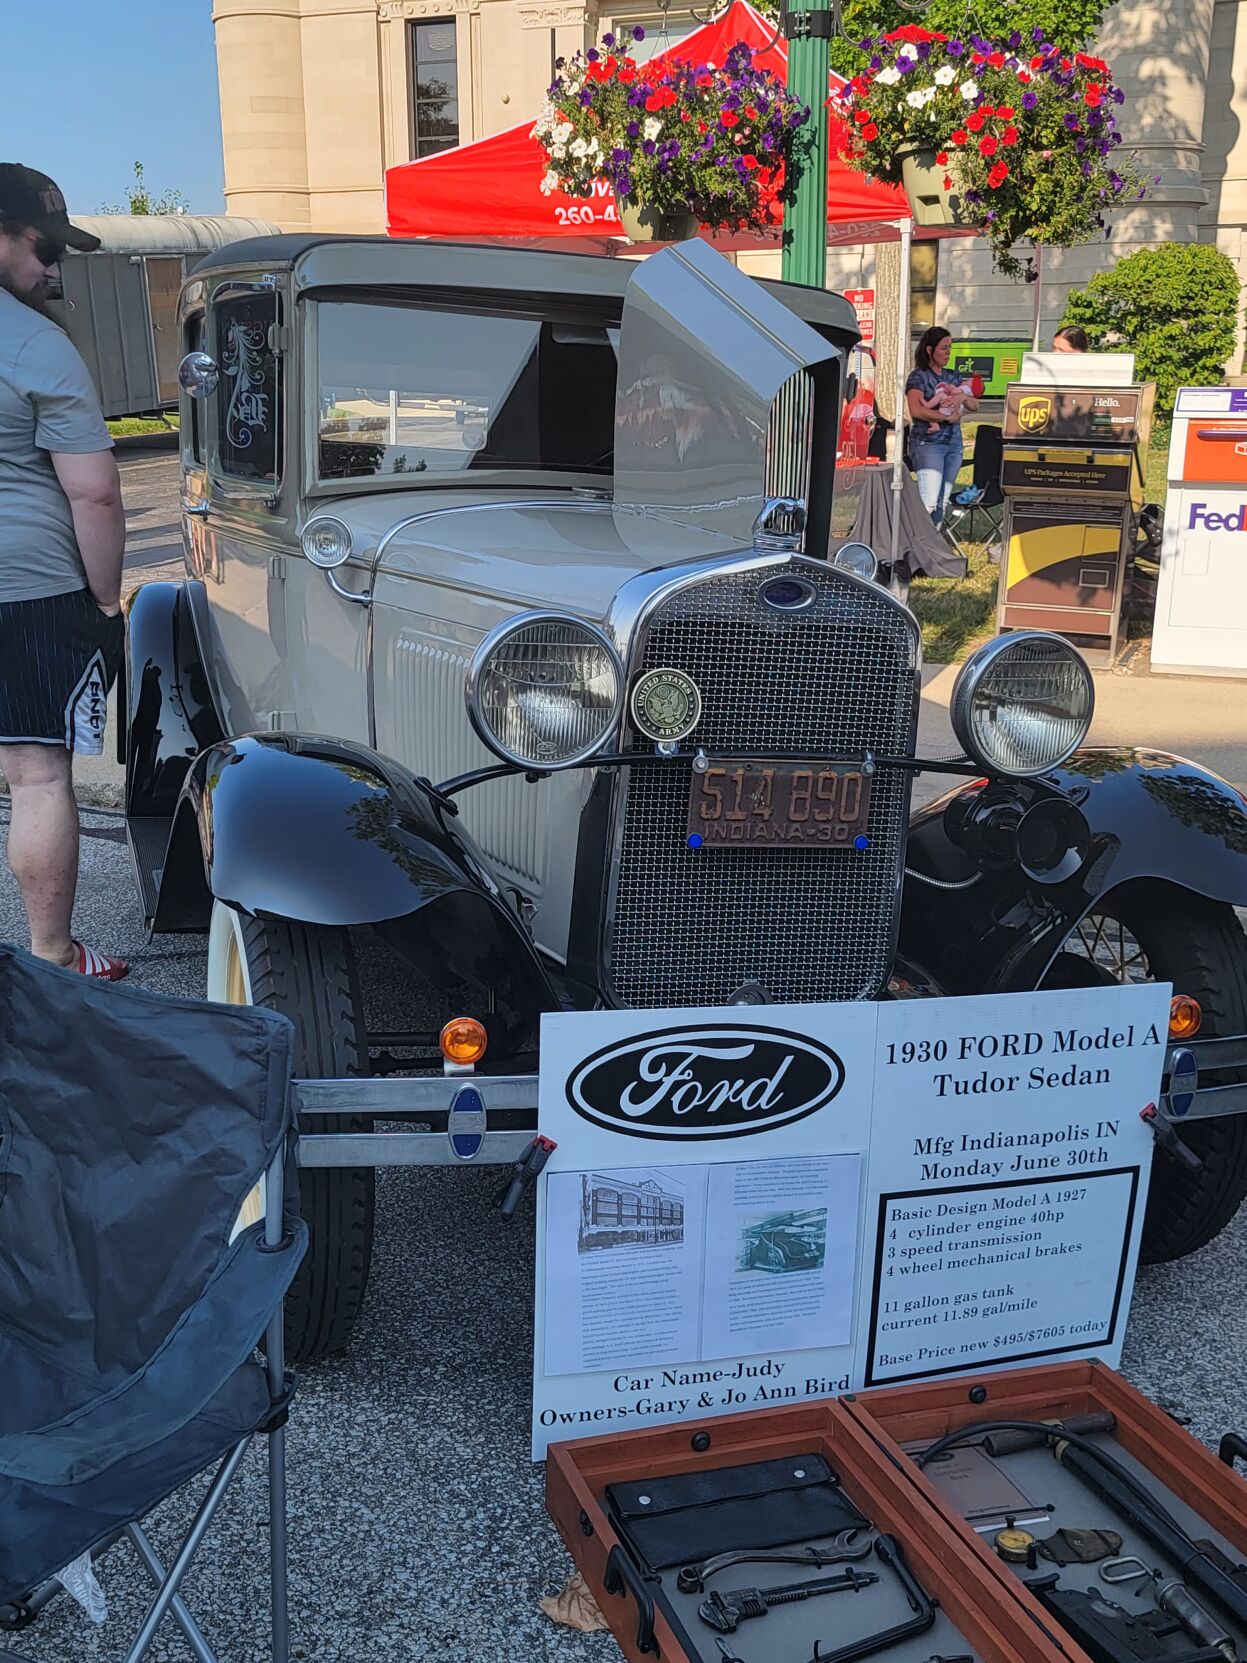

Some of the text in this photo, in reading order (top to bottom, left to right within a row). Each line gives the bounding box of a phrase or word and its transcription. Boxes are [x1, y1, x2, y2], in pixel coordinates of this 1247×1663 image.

[554, 205, 621, 225] 260-4
[854, 294, 864, 302] NO
[958, 362, 974, 373] GFL
[1020, 408, 1048, 428] ups
[1024, 468, 1036, 476] UPS
[1037, 469, 1063, 477] Packages
[1064, 470, 1091, 478] Accepted
[1188, 503, 1247, 532] Fed
[638, 675, 692, 707] UNITED STATES
[659, 723, 685, 736] ARMY
[700, 768, 863, 822] 514 890
[704, 822, 849, 841] INDIANA-30
[886, 1023, 1161, 1065] 1930 FORD Model A
[619, 1043, 795, 1118] Ford
[933, 1064, 1111, 1097] Tudor Sedan
[913, 1120, 1120, 1157] Mfg Indianapolis IN
[920, 1147, 1109, 1181] Monday June 30th
[890, 1188, 1088, 1222] Basic Design Model A 1927
[889, 1209, 1065, 1241] 4 cylinder engine 40hp
[886, 1242, 1083, 1277] 4 wheel mechanical brakes
[888, 1230, 1042, 1260] 3 speed transmission
[881, 1298, 1038, 1332] current 11.89 gal/mile
[884, 1284, 1015, 1314] 11 gallon gas tank
[878, 1318, 1108, 1367] Base Price new $495/$7605 today
[614, 1360, 786, 1392] Car Name-Judy
[540, 1374, 850, 1426] Owners-Gary & Jo Ann Bird
